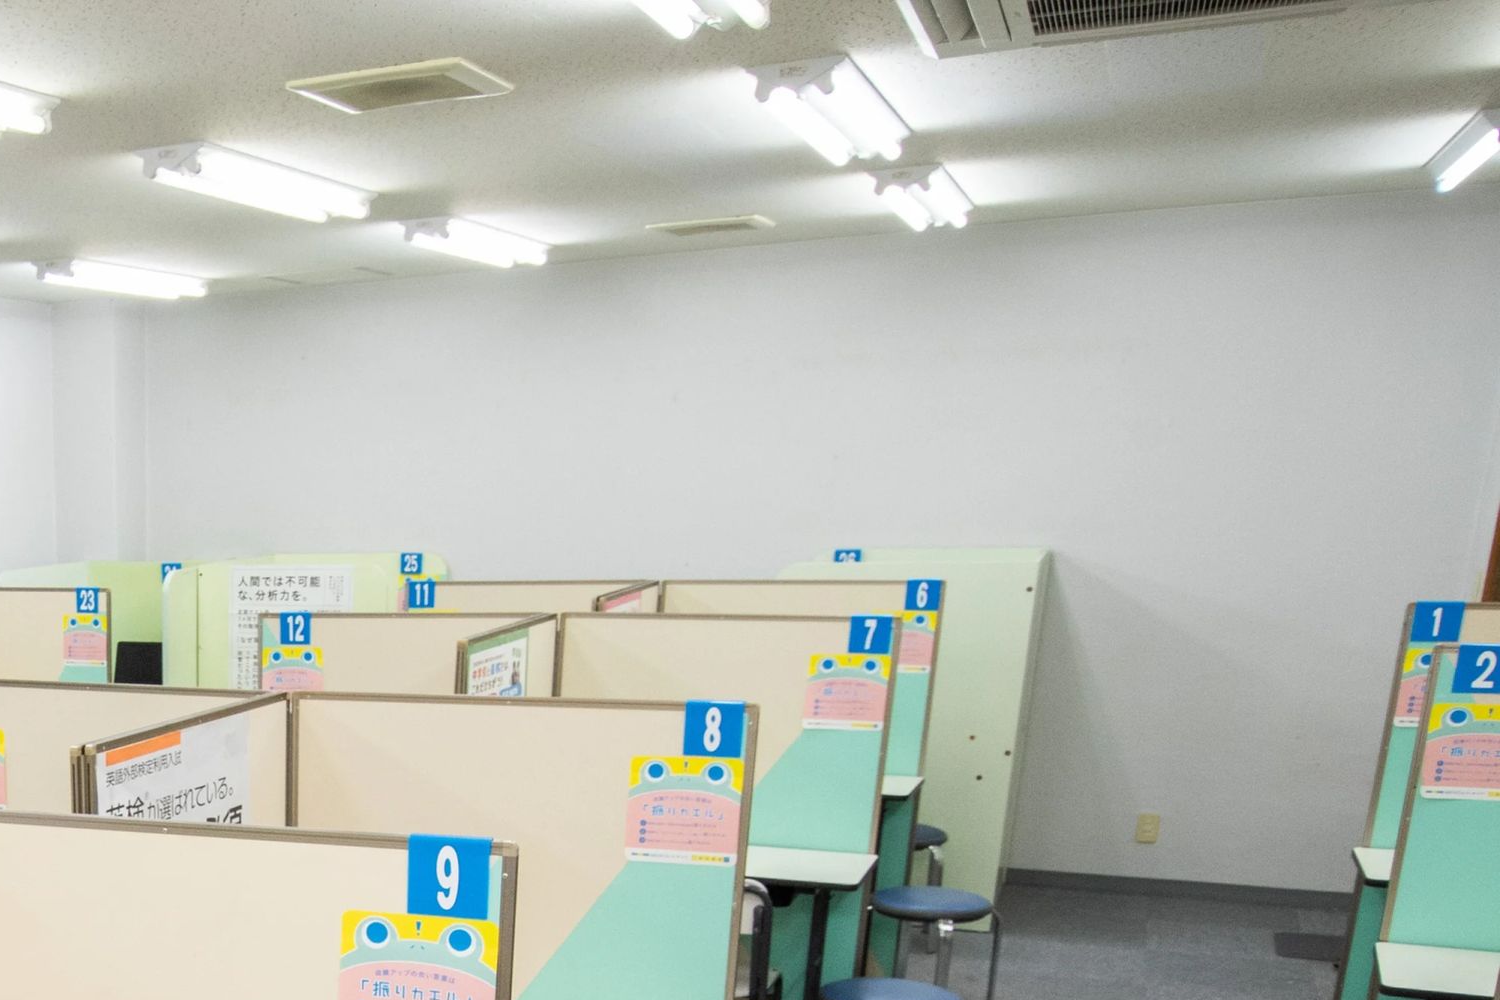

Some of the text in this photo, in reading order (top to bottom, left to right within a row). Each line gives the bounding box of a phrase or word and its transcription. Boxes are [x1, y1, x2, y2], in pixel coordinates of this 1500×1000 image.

[404, 555, 418, 572] 25
[238, 576, 321, 588] 人間では不可能
[415, 584, 428, 606] 11
[916, 582, 928, 608] 6
[80, 590, 95, 610] 23
[238, 590, 308, 602] な、分析力を。
[287, 616, 304, 642] 12
[864, 619, 877, 650] 7
[1432, 607, 1443, 637] 1
[1471, 651, 1497, 689] 2
[703, 707, 722, 752] 8
[436, 845, 460, 910] 9
